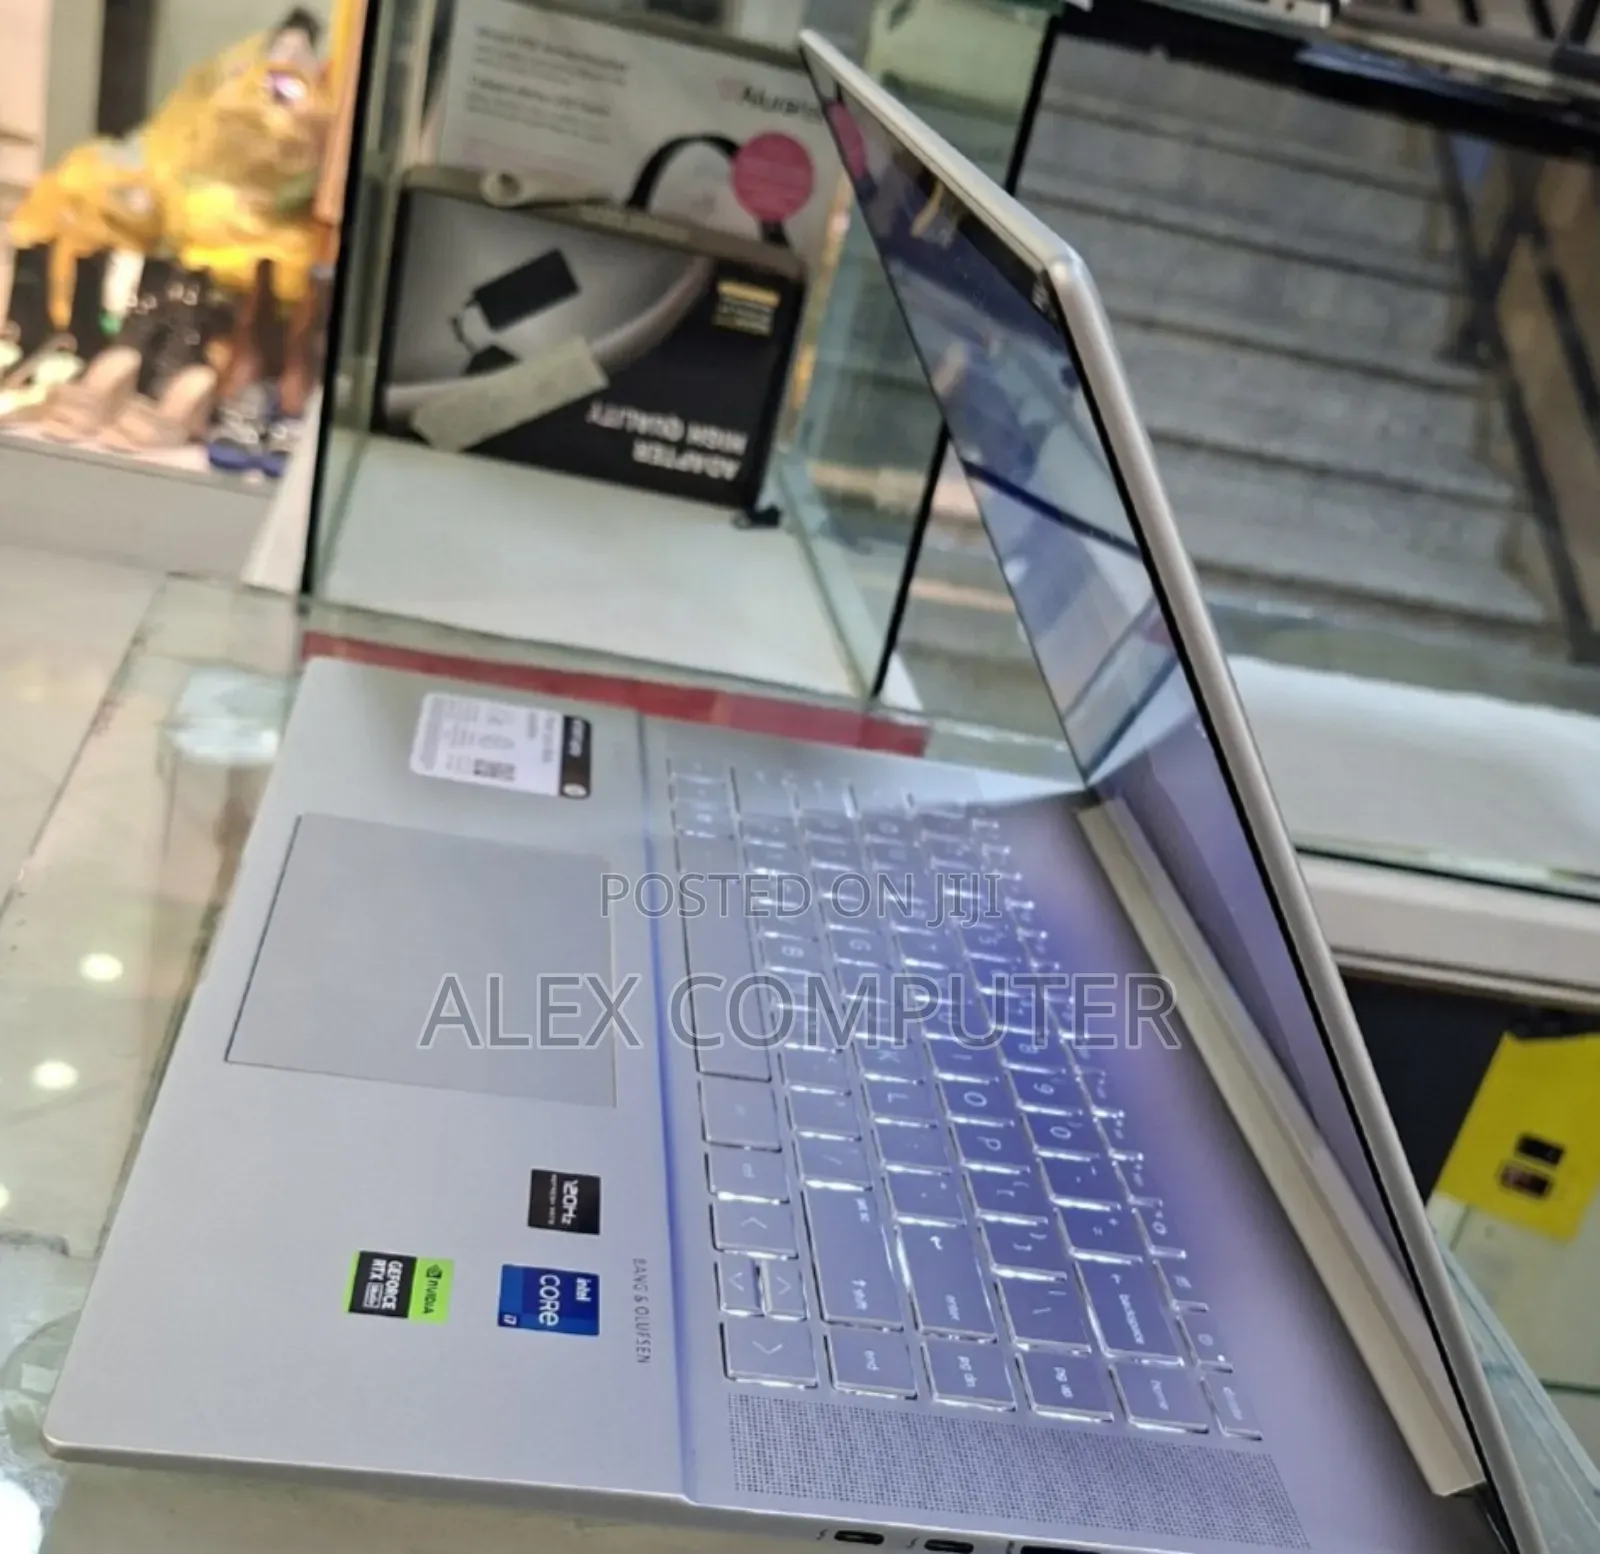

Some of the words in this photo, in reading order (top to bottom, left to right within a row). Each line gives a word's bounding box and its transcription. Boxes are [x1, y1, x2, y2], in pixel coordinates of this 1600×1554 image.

[1032, 1082, 1055, 1095] 9
[977, 1135, 1002, 1151] P
[561, 1179, 579, 1225] 120Hz
[369, 1258, 387, 1280] RTX
[632, 1258, 649, 1292] BANG
[381, 1260, 403, 1311] GEFORCE
[575, 1277, 592, 1302] intel
[852, 1289, 868, 1311] shift
[945, 1294, 961, 1321] enter
[1119, 1293, 1145, 1345] backspace
[634, 1305, 652, 1364] OLUFSEN
[864, 1349, 880, 1372] end
[957, 1355, 972, 1372] pg
[1054, 1366, 1068, 1383] pg
[1151, 1379, 1169, 1411] home
